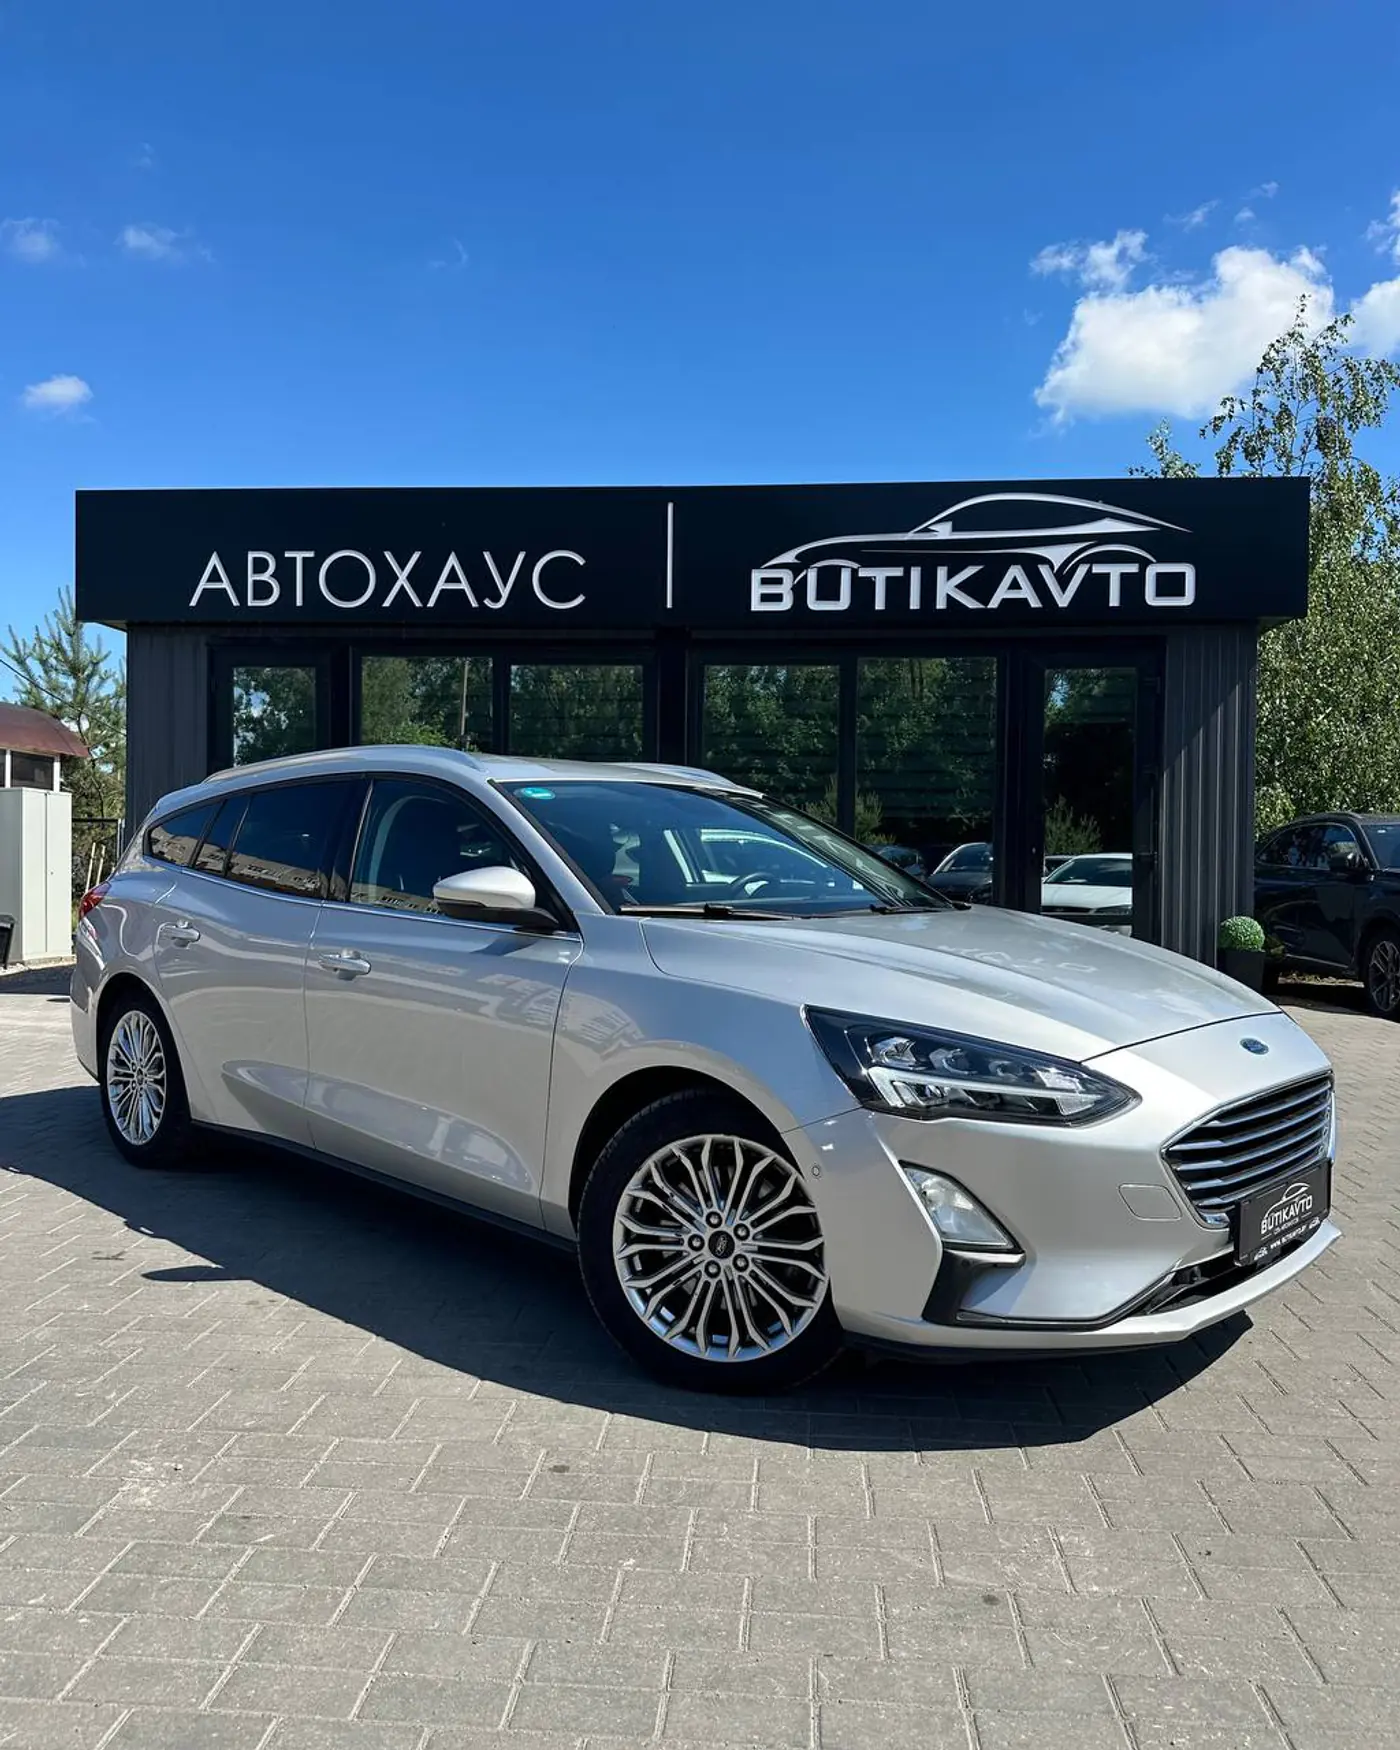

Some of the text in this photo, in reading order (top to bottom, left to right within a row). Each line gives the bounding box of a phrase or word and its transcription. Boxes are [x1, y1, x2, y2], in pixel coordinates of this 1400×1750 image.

[189, 549, 586, 610] АВТОХАУС
[750, 561, 1196, 612] BUTIKAVTO
[1260, 1194, 1313, 1235] BUTIKAVTO
